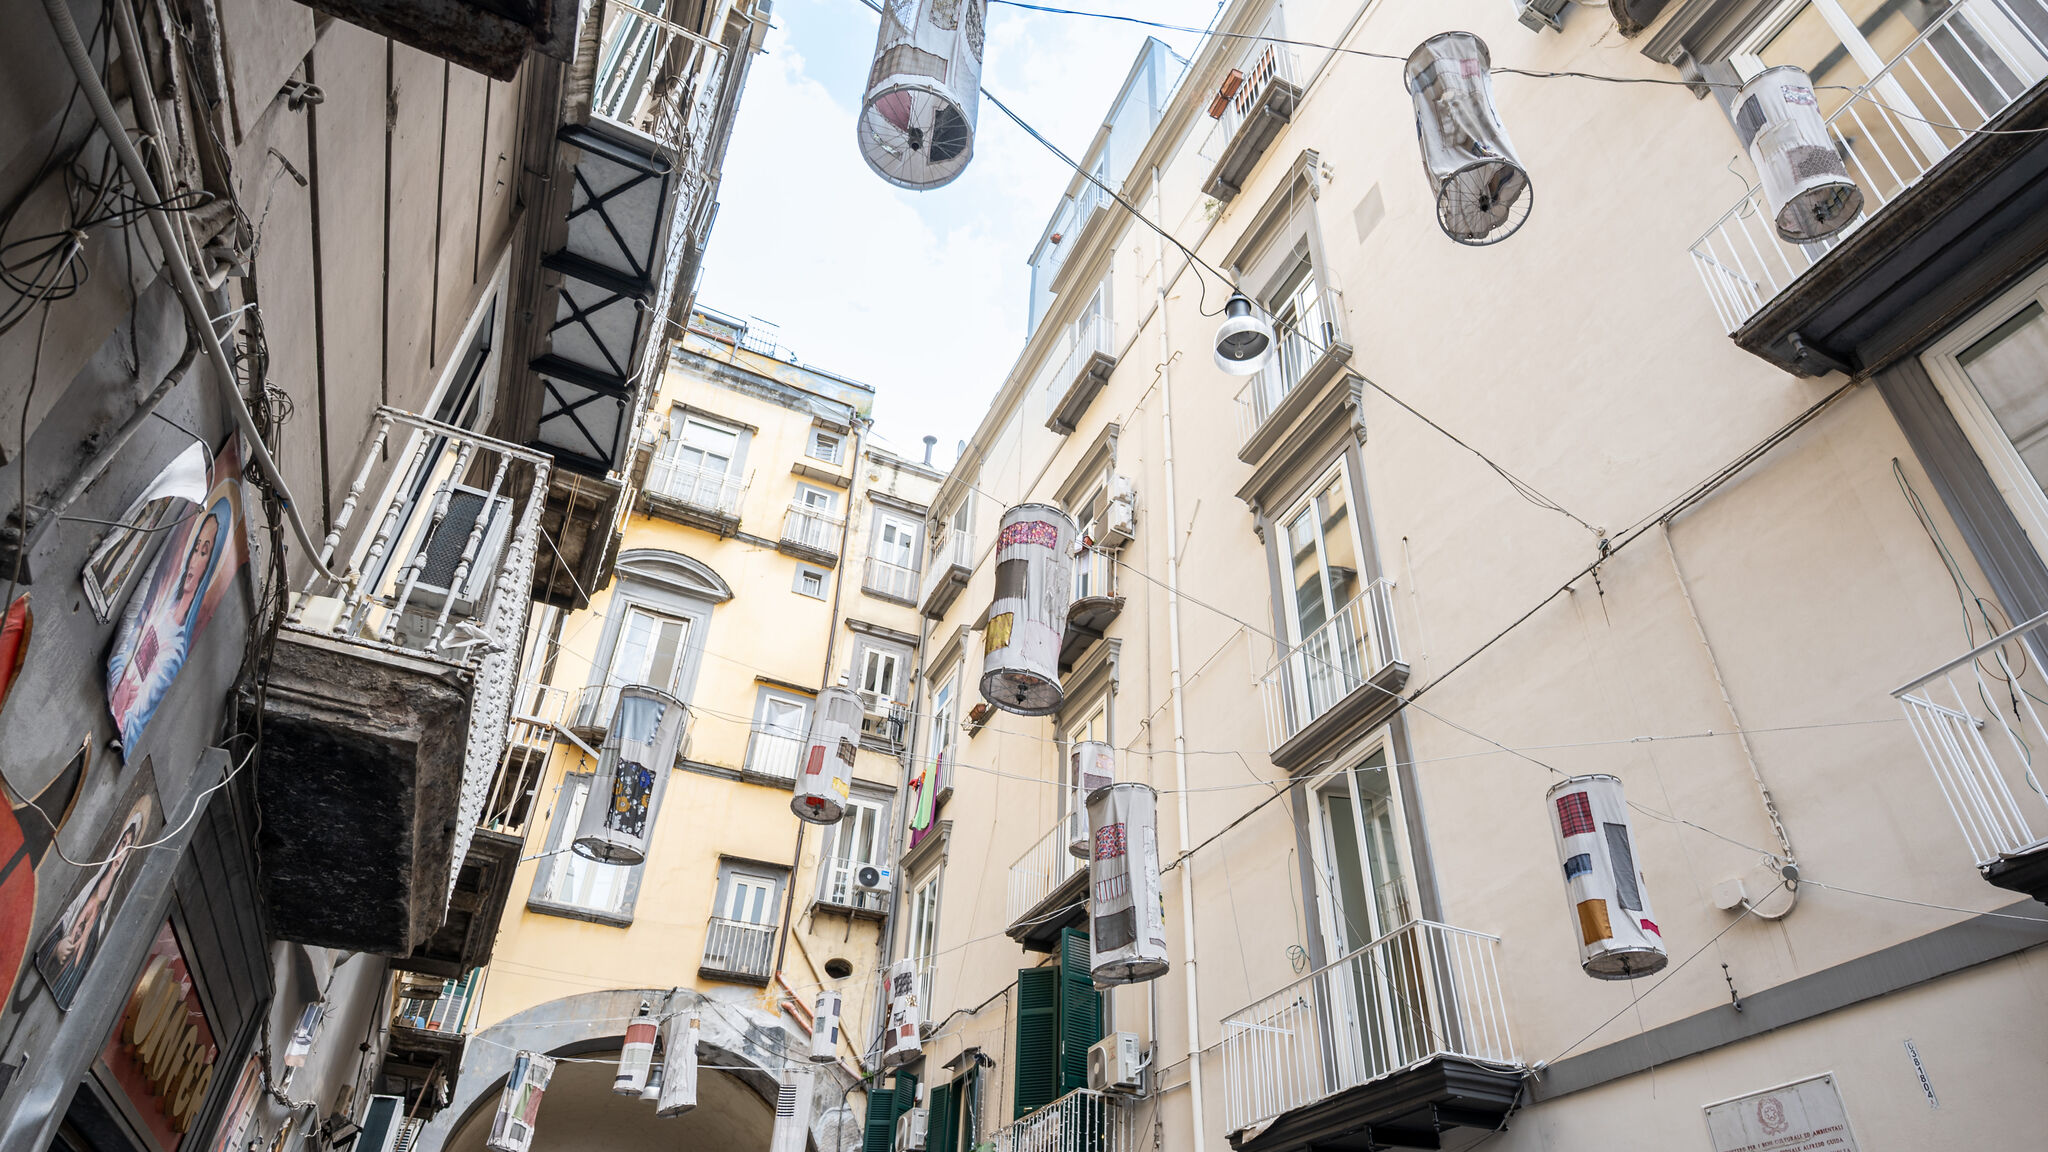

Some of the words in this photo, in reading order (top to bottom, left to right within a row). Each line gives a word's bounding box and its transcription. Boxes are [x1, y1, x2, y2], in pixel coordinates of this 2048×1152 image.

[1774, 1134, 1802, 1144] CULTURALI
[1812, 1124, 1844, 1136] AMBIENTALI
[1803, 1141, 1825, 1151] ALFREDO
[1826, 1137, 1844, 1145] GUIDA
